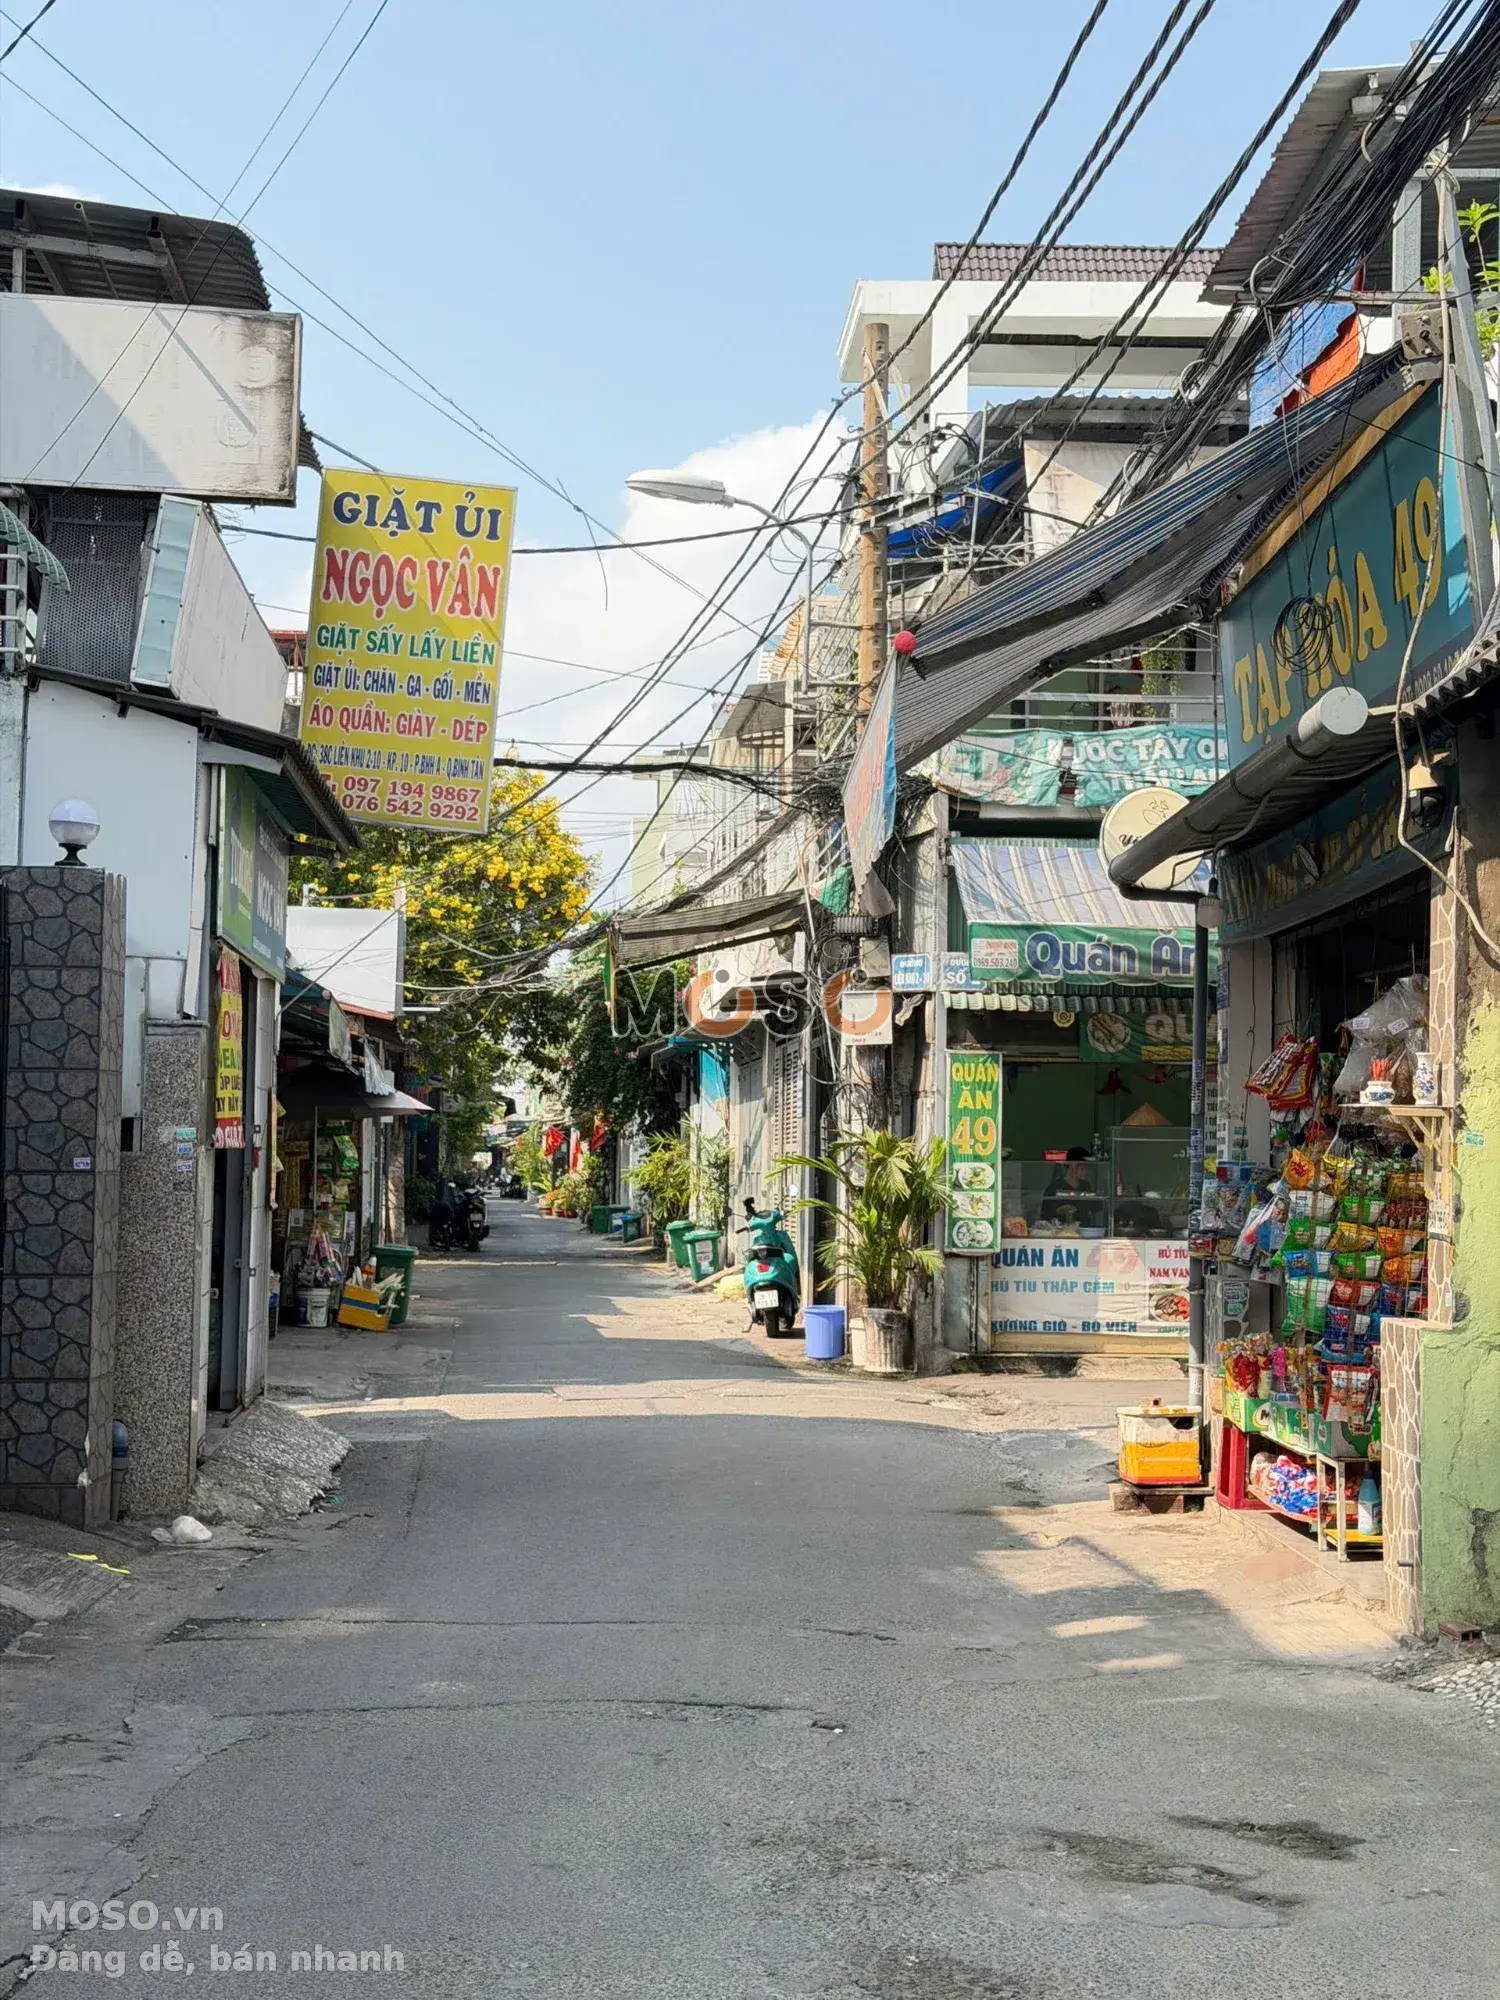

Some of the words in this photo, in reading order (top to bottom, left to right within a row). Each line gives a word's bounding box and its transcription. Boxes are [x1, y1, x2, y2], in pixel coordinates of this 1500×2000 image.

[333, 487, 442, 537] GIẶT
[454, 491, 502, 541] ỦI
[1394, 476, 1441, 618] 49
[322, 547, 418, 619] NGỌC
[426, 546, 501, 619] VÂN
[317, 622, 360, 655] GIẶT
[366, 624, 403, 655] SẤY
[409, 629, 446, 660] LẤY
[451, 632, 496, 666] LIỀN
[313, 661, 341, 693] GIẶT
[344, 659, 360, 692] ỦI:
[363, 667, 396, 695] CHĂN
[406, 674, 421, 698] GA
[432, 670, 453, 700] GỐI
[464, 672, 491, 704] MỀN
[308, 698, 334, 727] ÁO
[339, 700, 390, 733] QUẦN:
[396, 707, 436, 738] GIÀY
[452, 714, 489, 743] DÉP
[400, 753, 409, 773] 10
[344, 776, 381, 793] 097
[388, 780, 424, 798] 194
[431, 785, 481, 804] 9867
[342, 794, 379, 812] 076
[385, 799, 423, 816] 542
[428, 802, 479, 822] 9292
[1024, 930, 1139, 979] Quán
[946, 967, 967, 985] SỐ
[951, 1055, 999, 1083] QUÁN
[957, 1085, 993, 1110] ĂN
[951, 1116, 997, 1156] 49
[990, 1244, 1044, 1269] QUÁN
[1051, 1245, 1079, 1268] ĂN
[1158, 1245, 1172, 1259] HỦ
[1013, 1278, 1037, 1293] TÍU
[1041, 1278, 1079, 1295] THẬP
[1150, 1267, 1170, 1278] NAM
